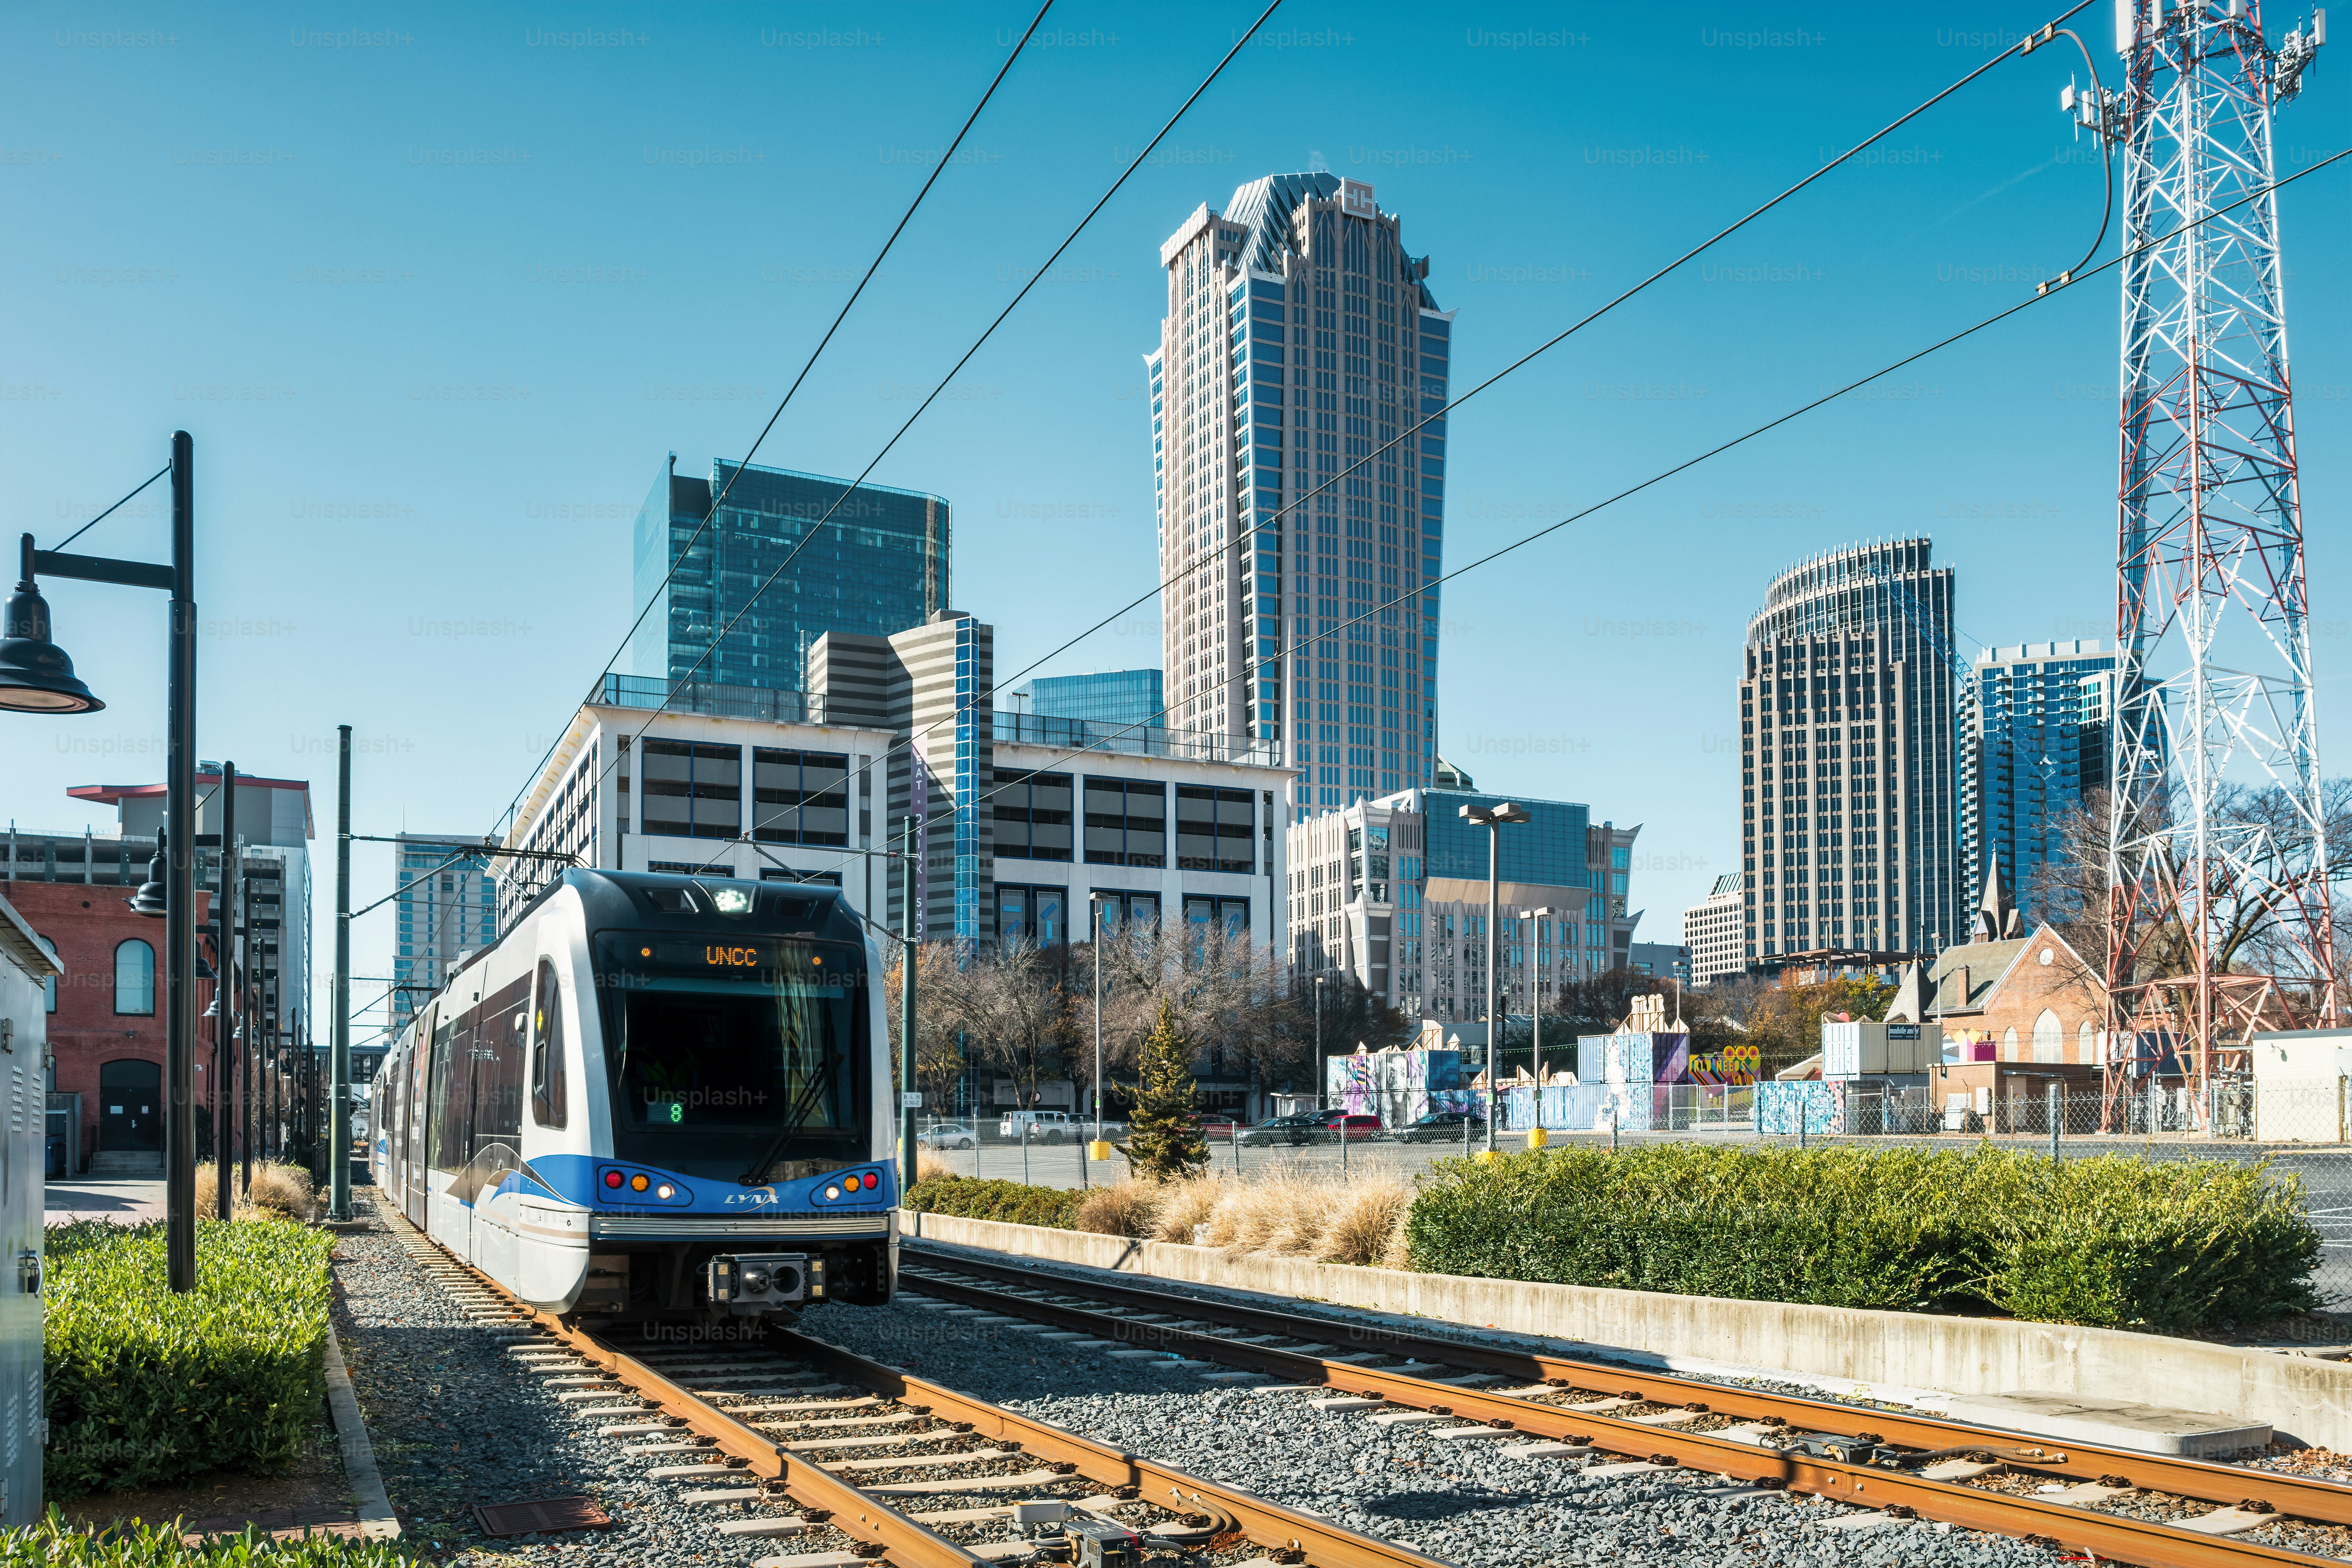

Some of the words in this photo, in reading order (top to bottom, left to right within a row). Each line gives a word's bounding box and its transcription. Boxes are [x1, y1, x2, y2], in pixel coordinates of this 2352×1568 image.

[1160, 201, 1208, 268] TRUIST
[707, 946, 757, 966] UNCC
[671, 1104, 682, 1122] 8
[724, 1195, 780, 1204] LYNX
